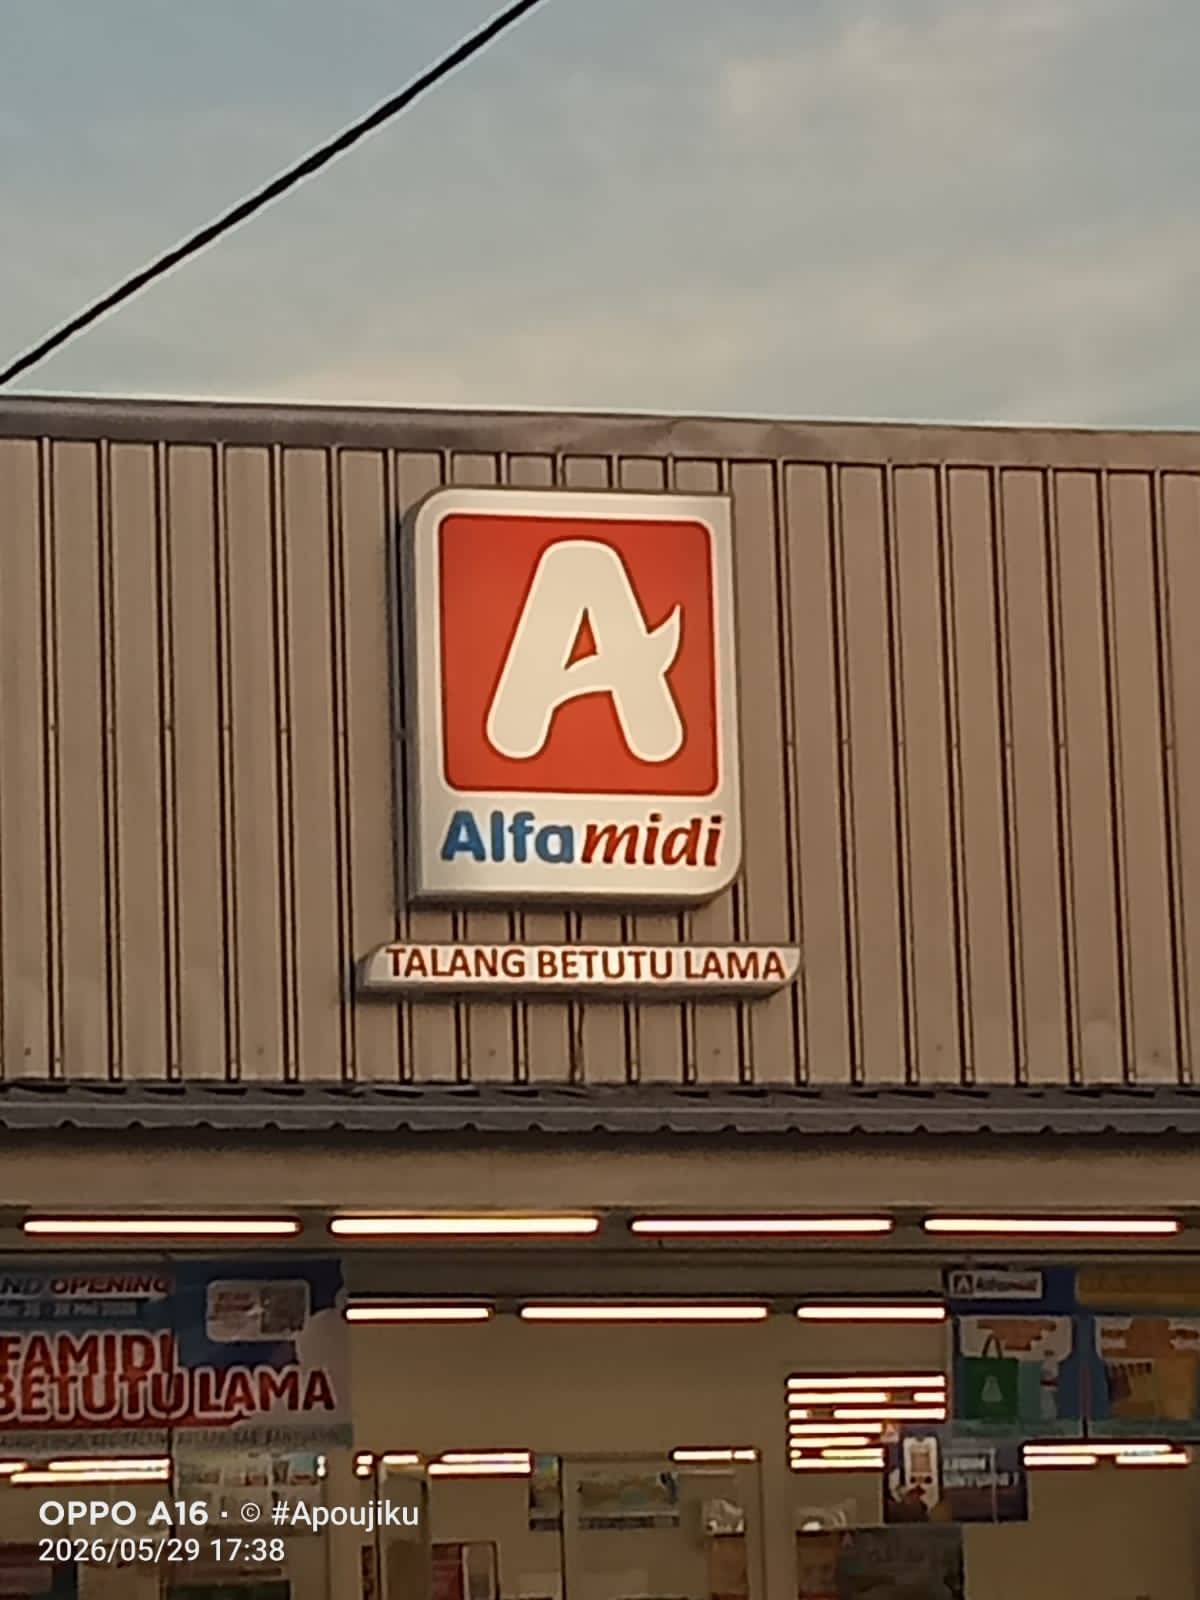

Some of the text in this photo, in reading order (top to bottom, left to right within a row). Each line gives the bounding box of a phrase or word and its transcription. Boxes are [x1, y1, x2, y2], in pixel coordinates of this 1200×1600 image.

[440, 810, 723, 867] Alfamidi
[386, 948, 786, 980] TALANG BETUTU LAMA
[50, 1275, 170, 1295] OPENING
[202, 1370, 335, 1412] LAMA
